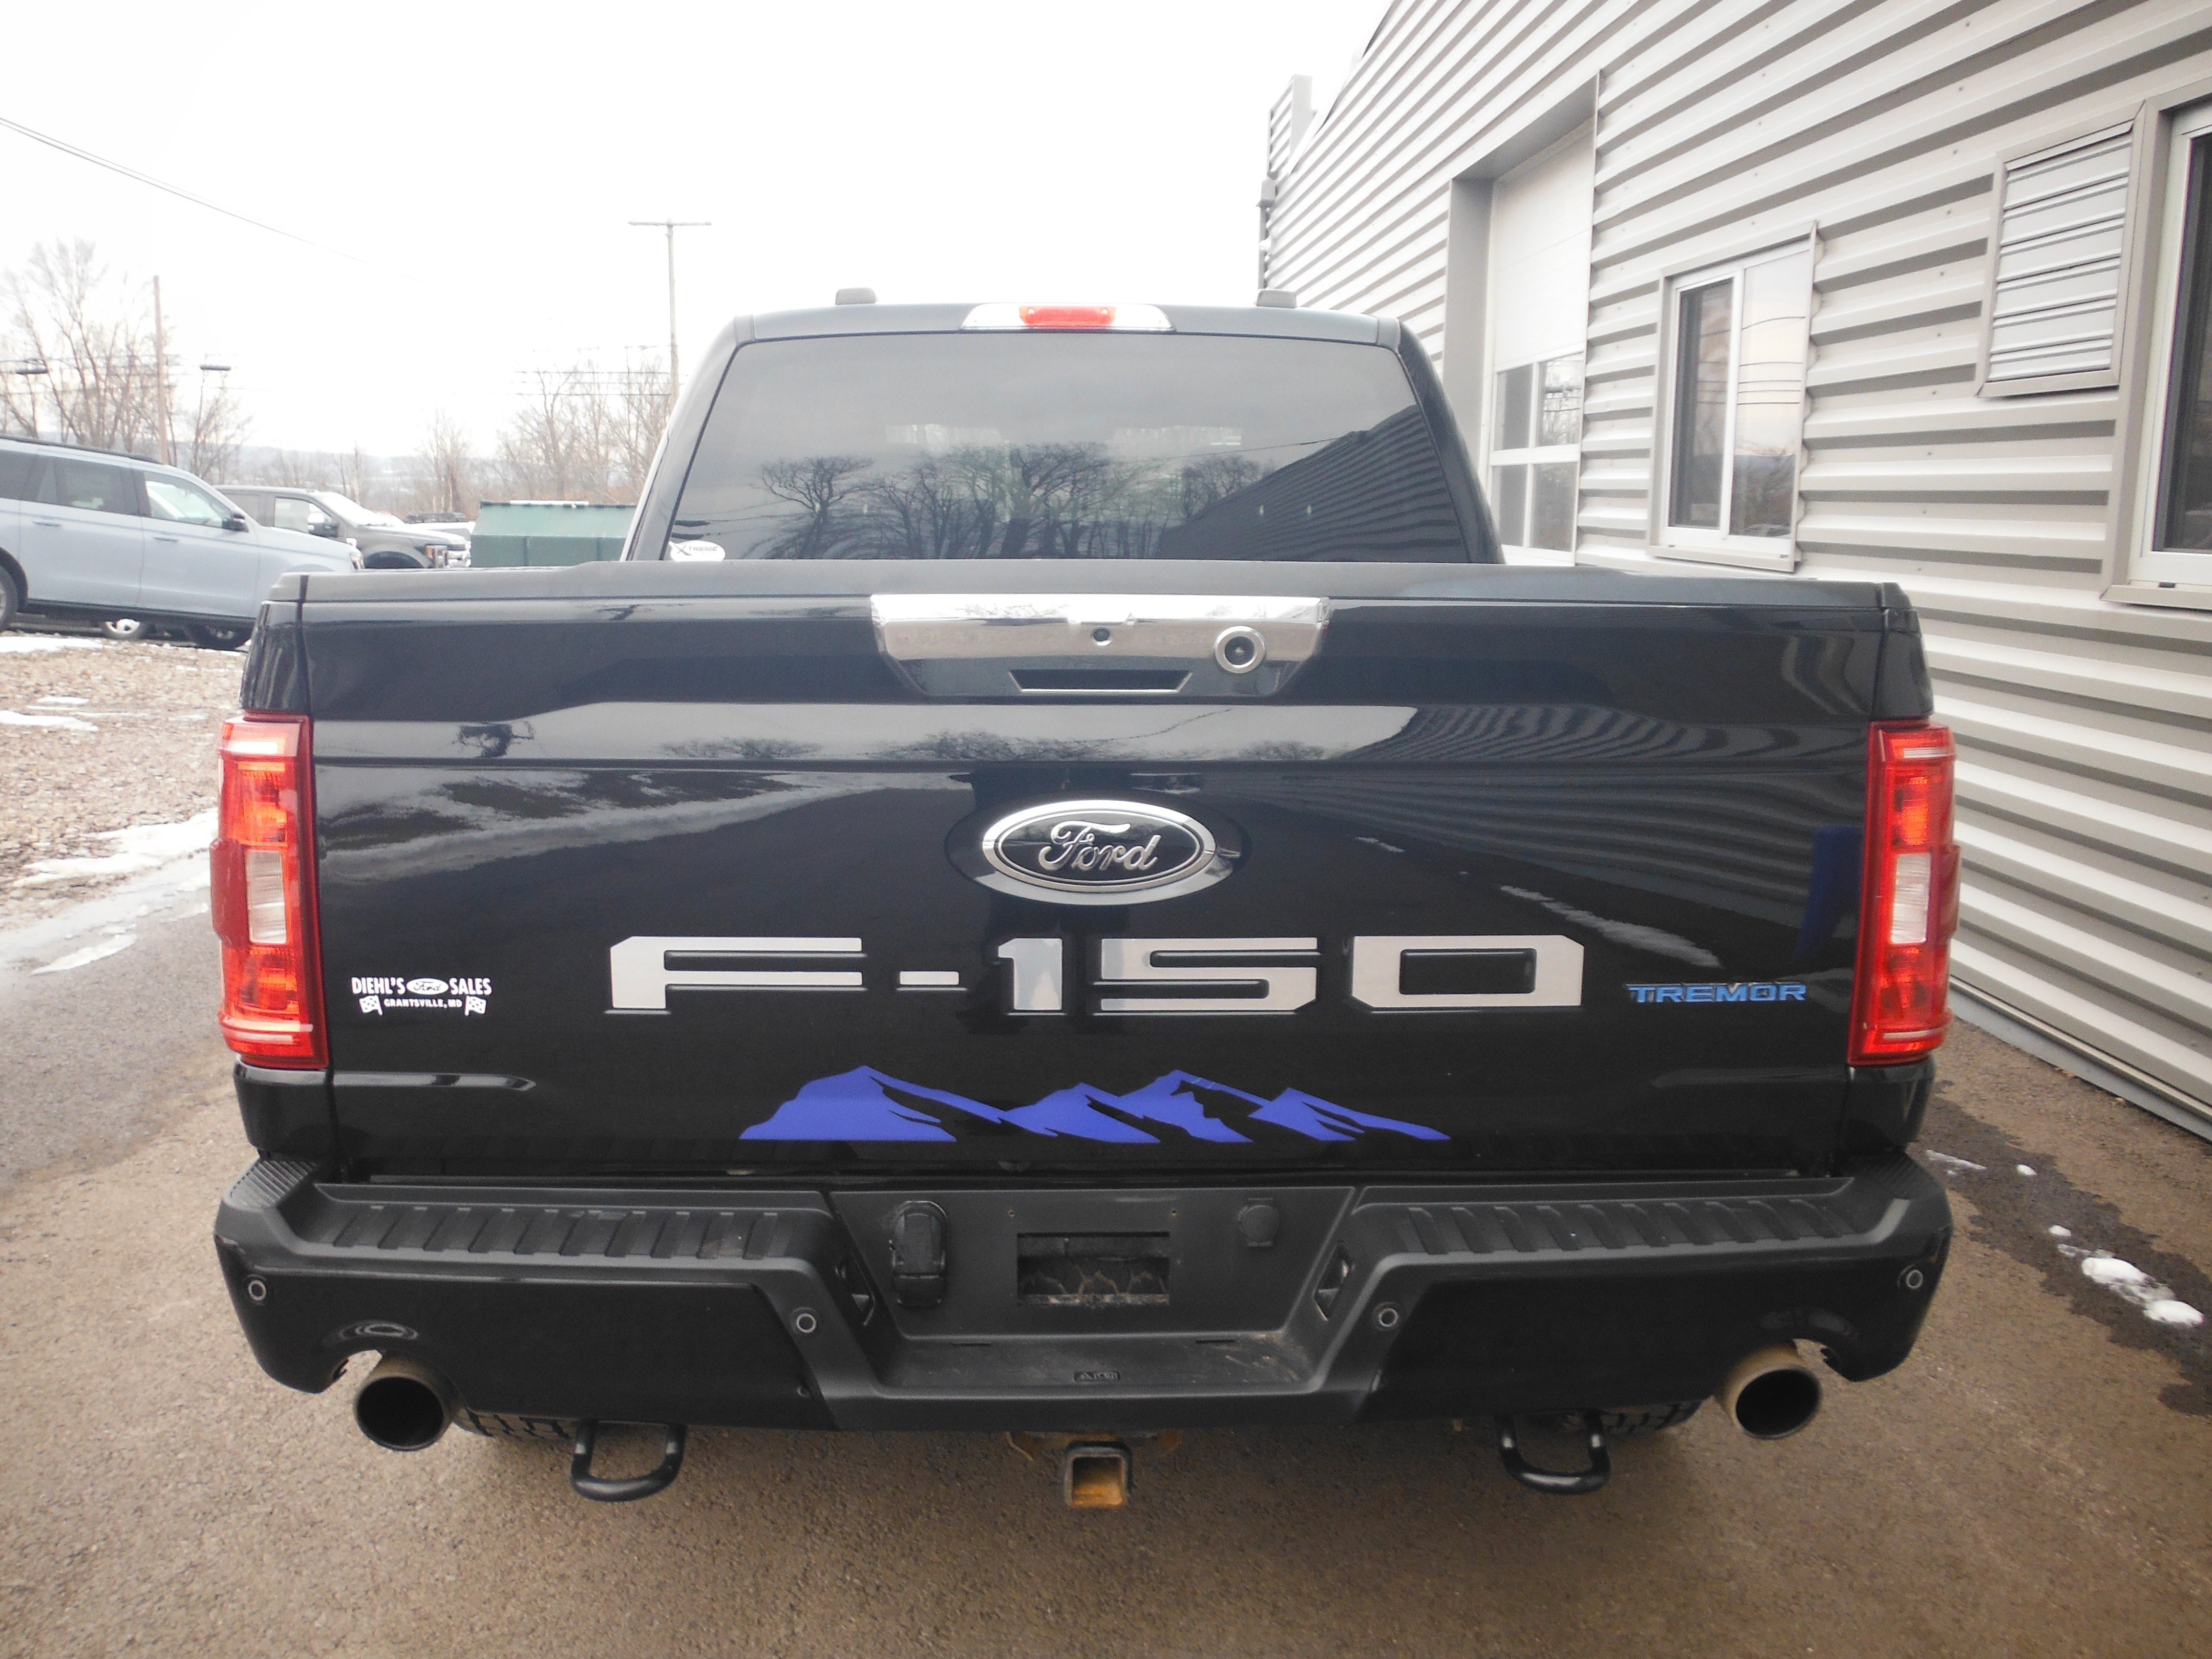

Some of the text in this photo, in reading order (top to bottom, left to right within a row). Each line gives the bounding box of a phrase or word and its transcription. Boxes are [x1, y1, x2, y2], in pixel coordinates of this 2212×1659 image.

[1038, 821, 1161, 870] Ford
[609, 935, 1585, 1011] F-150
[351, 977, 406, 995] DIEHL'S
[449, 977, 492, 995] SALES
[1627, 982, 1807, 1003] TREMOR
[384, 998, 463, 1009] GRANTSVILLE, MD
